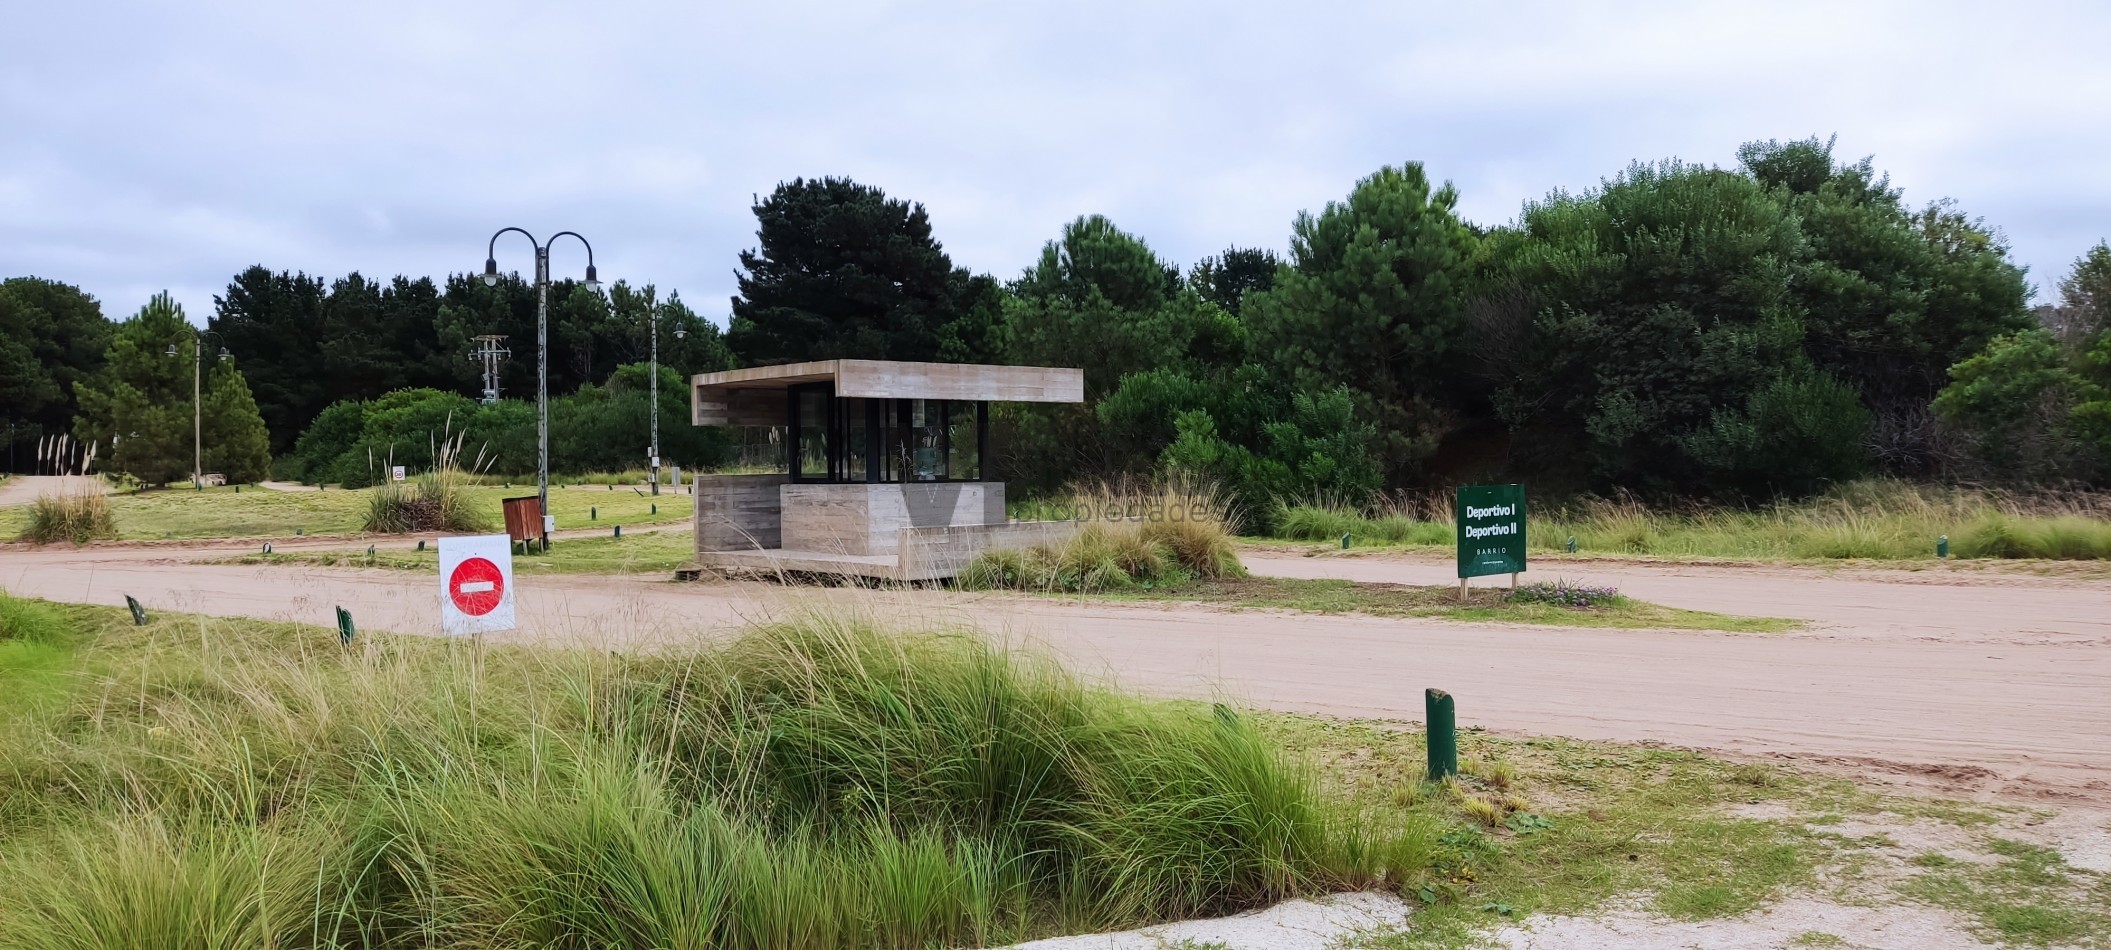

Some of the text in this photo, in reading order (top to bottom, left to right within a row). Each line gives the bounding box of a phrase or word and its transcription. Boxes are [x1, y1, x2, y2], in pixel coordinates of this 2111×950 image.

[1466, 503, 1515, 520] Deportivo I
[1465, 522, 1517, 539] Deportivo II
[1476, 547, 1507, 555] BARRIO
